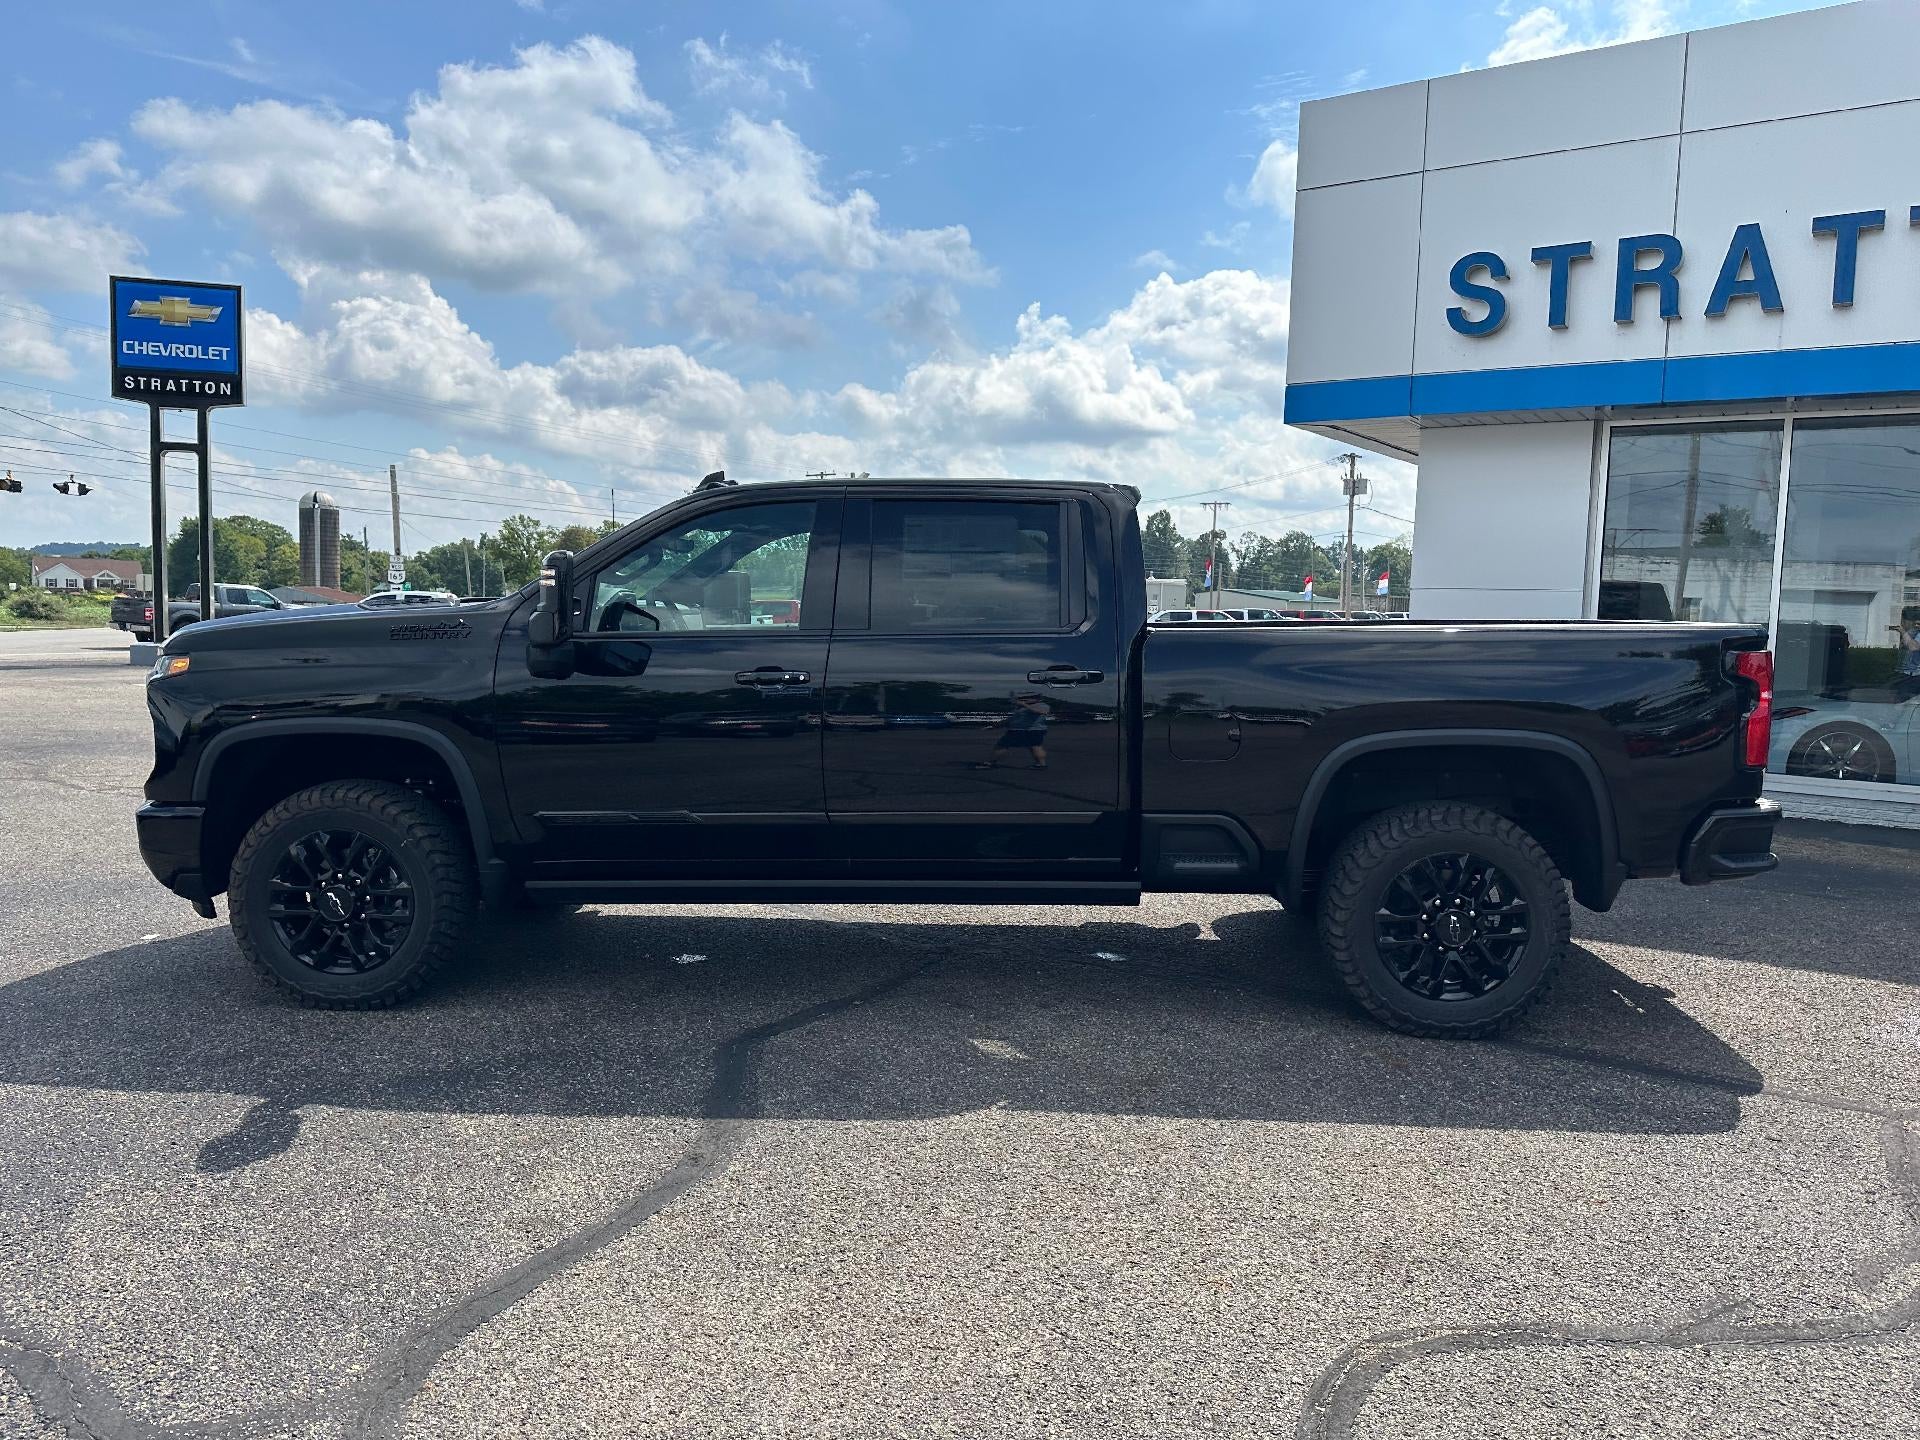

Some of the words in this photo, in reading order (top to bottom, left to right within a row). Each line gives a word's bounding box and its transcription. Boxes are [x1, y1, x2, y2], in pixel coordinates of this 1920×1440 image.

[1446, 205, 1920, 338] STRAT
[122, 340, 230, 361] CHEVROLET
[124, 375, 231, 396] STRATTON
